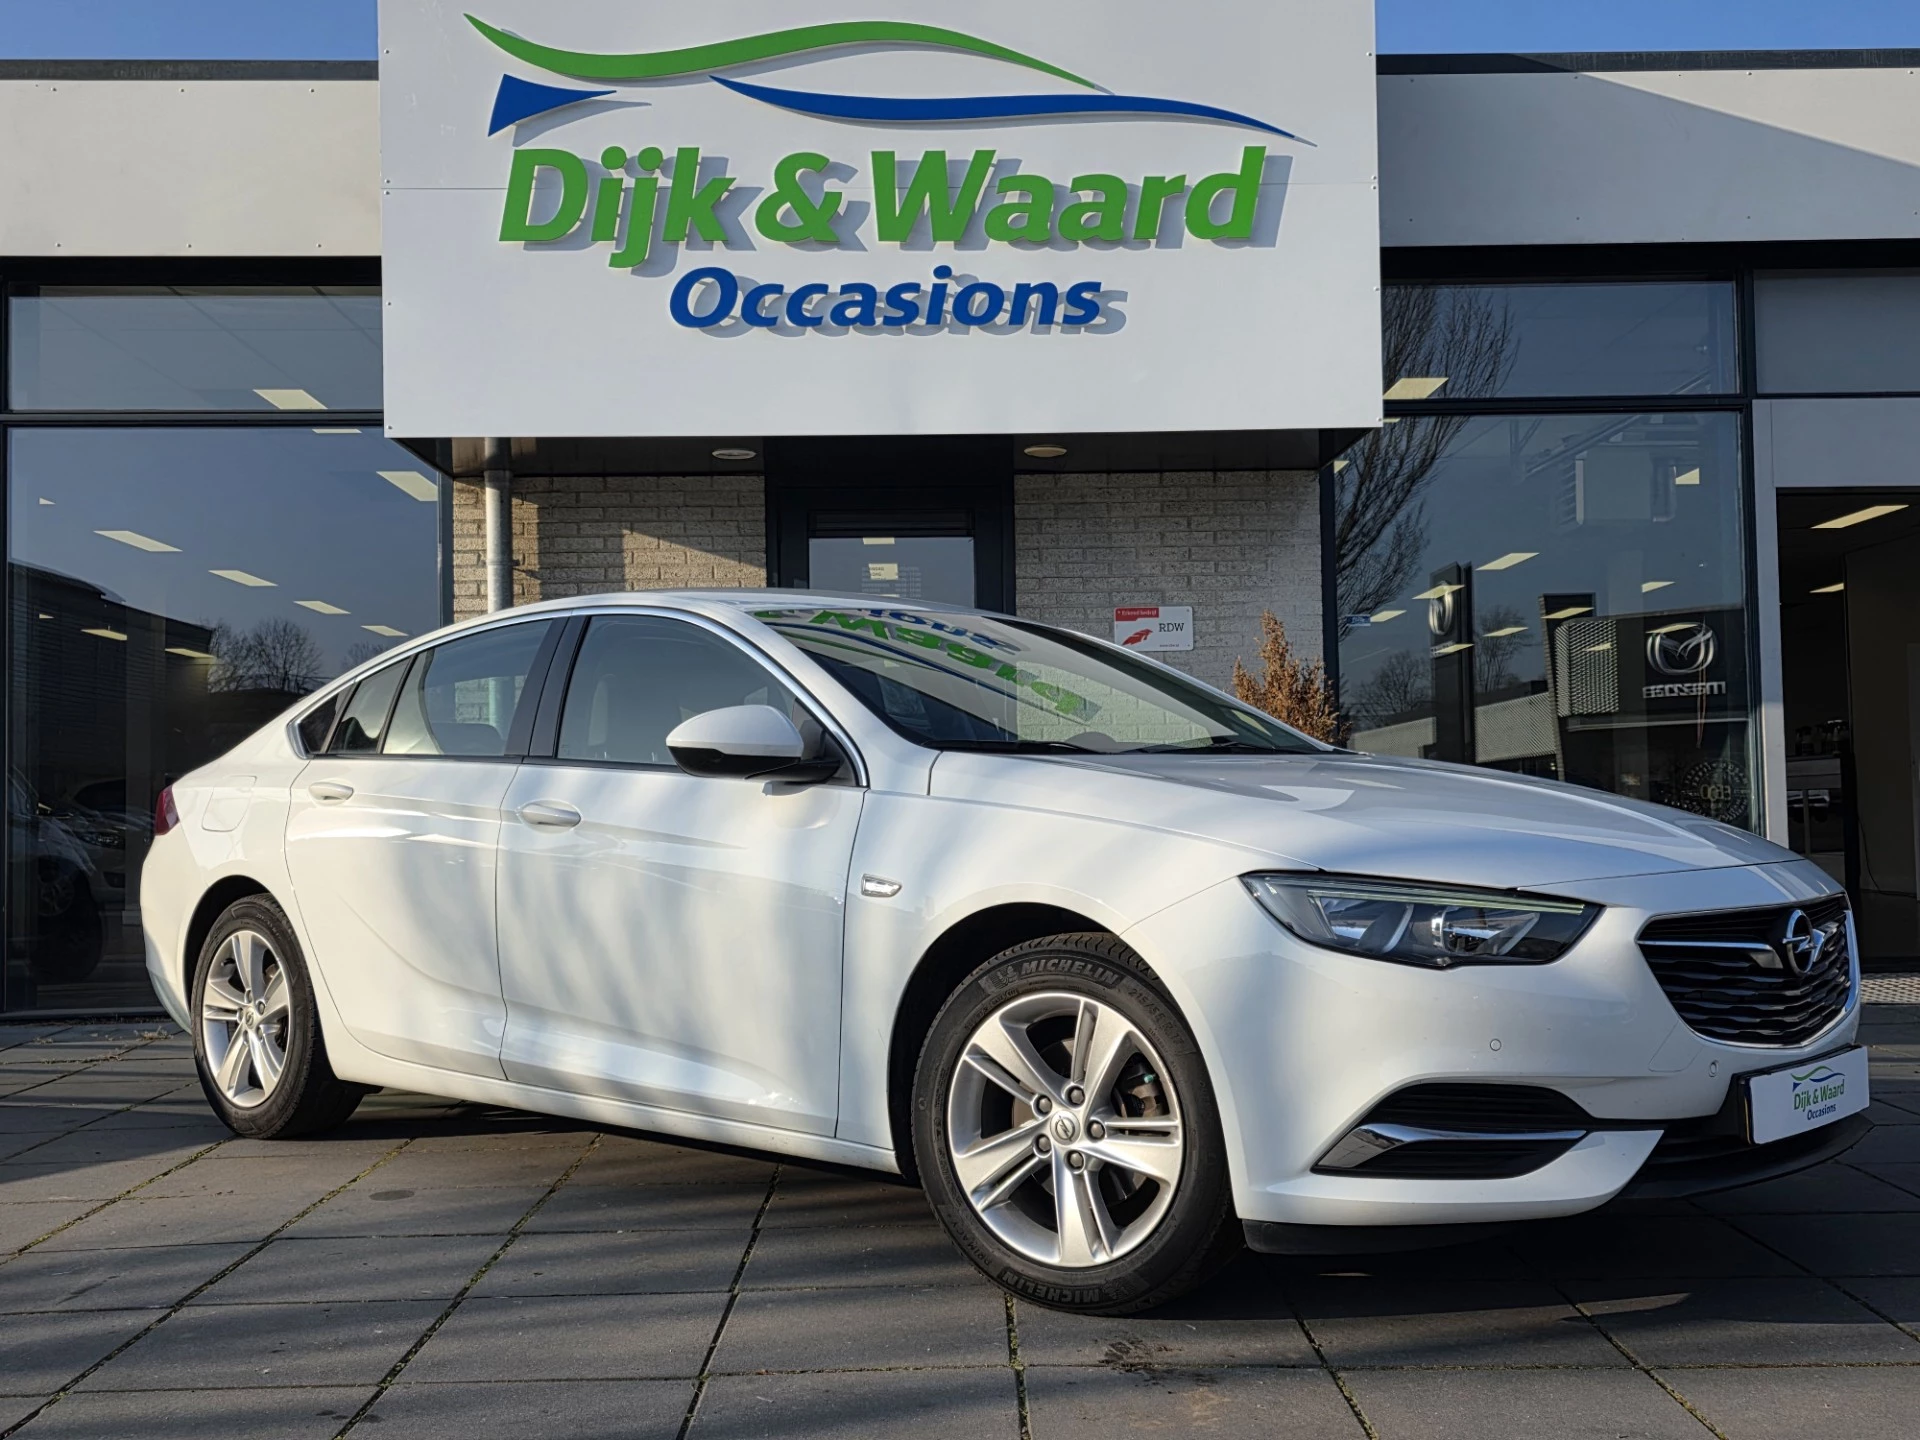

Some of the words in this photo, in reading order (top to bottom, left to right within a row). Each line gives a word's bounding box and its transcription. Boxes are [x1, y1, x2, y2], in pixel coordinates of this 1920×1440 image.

[499, 146, 737, 268] Dijk
[754, 152, 842, 242] &
[872, 146, 1266, 241] Waard
[669, 265, 1102, 329] Occasions
[1158, 622, 1185, 633] RDW
[1020, 959, 1120, 985] MICHELIN
[1793, 1091, 1812, 1112] Dijk
[1812, 1089, 1820, 1105] &
[1820, 1079, 1845, 1102] Waard
[1807, 1103, 1836, 1120] Occasions
[1002, 1270, 1101, 1303] MICHELIN
